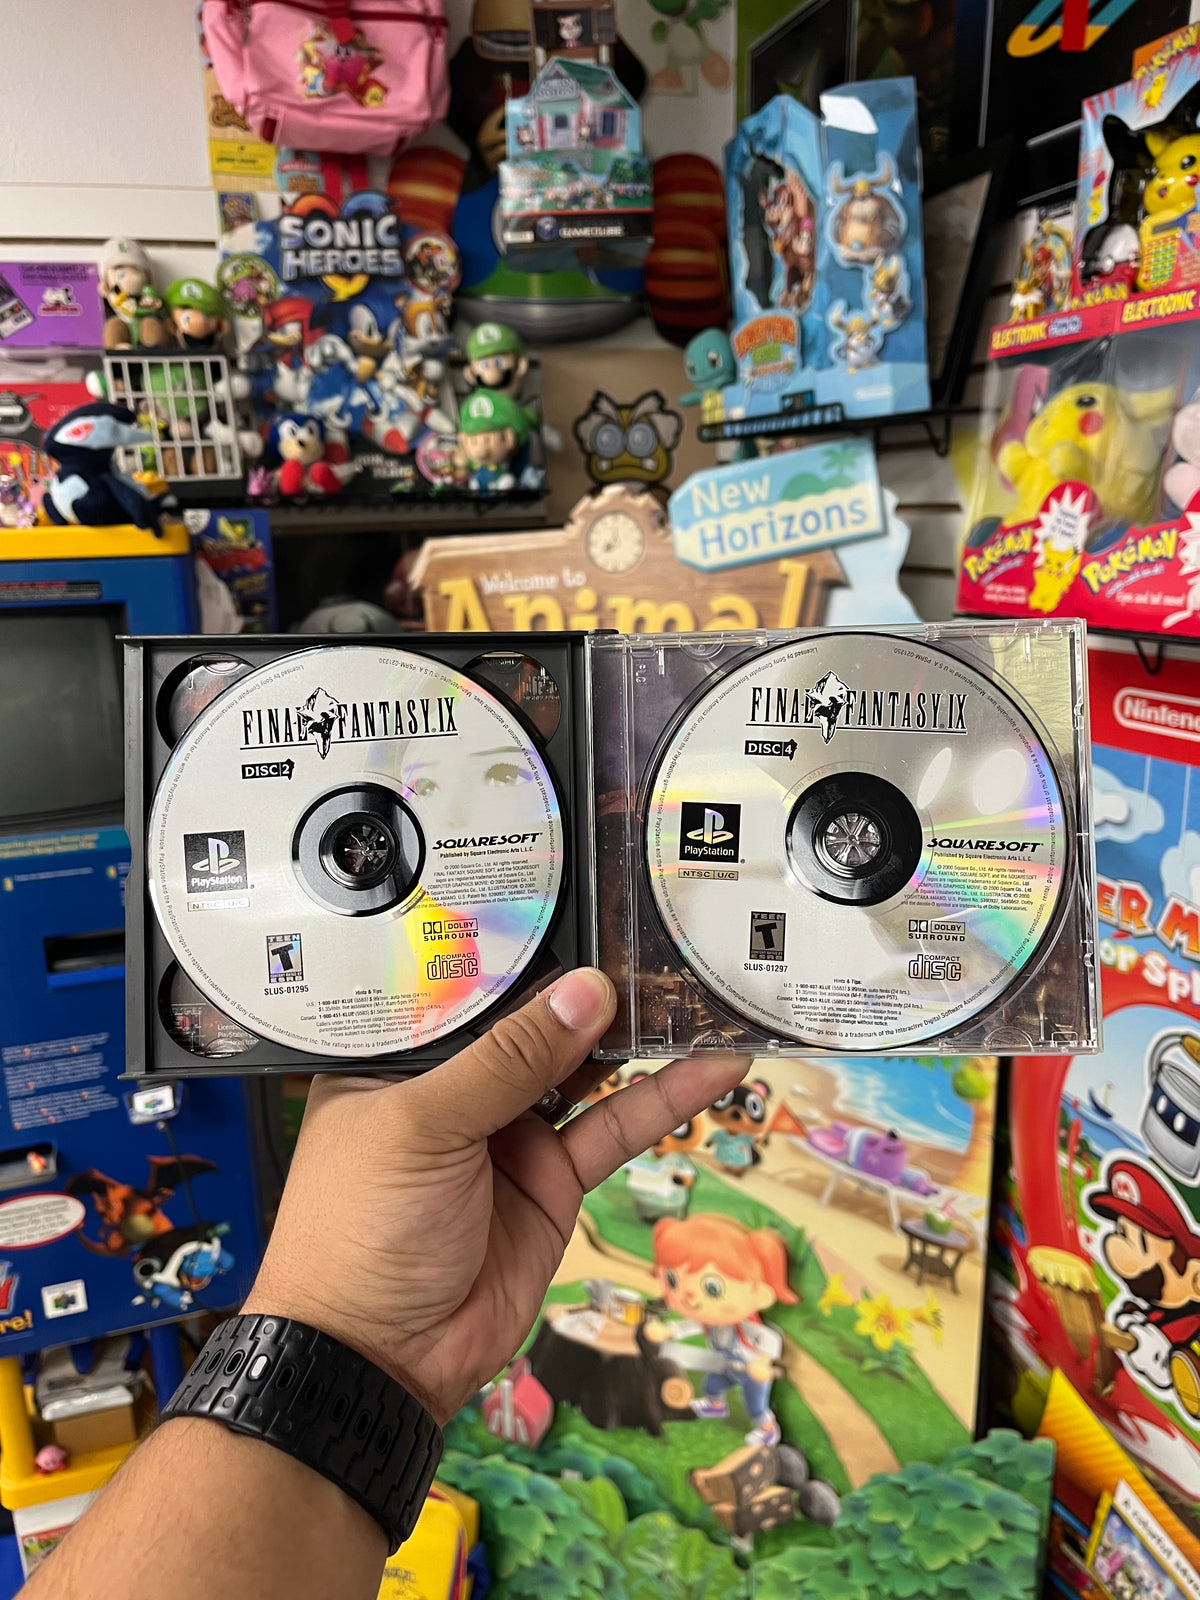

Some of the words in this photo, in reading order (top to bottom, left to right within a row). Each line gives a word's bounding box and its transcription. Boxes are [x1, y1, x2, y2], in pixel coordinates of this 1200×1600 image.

[279, 214, 400, 249] SONIC
[282, 249, 404, 281] HEROES
[1122, 289, 1196, 323] ELECTRONIC
[991, 321, 1048, 350] ELECTRONIC
[691, 474, 770, 517] New
[700, 494, 868, 560] Horizons
[480, 571, 559, 596] Welcome
[562, 569, 587, 589] to
[280, 664, 303, 676] Licensed
[259, 676, 272, 686] Sony
[439, 675, 472, 696] Manufactured
[236, 683, 260, 701] Computer
[207, 699, 237, 727] Entertainment
[482, 703, 504, 724] applicable
[750, 686, 814, 724] FINAL
[241, 706, 309, 746] FINAL
[193, 725, 210, 745] America
[506, 728, 523, 748] violation
[747, 742, 781, 755] DISC
[784, 743, 793, 755] 4
[176, 762, 186, 773] with
[244, 763, 279, 778] DISC
[281, 763, 290, 776] 2
[525, 756, 536, 770] game
[532, 770, 540, 780] this
[163, 782, 176, 812] PlayStation
[539, 787, 550, 812] broadcast
[432, 832, 542, 850] SQUARESOFT
[926, 838, 1041, 853] SQUARESOFT
[684, 845, 735, 858] PlayStation
[191, 875, 243, 889] PlayStation
[192, 901, 221, 910] NTSC
[228, 898, 246, 908] U/C
[166, 904, 180, 933] PlayStation
[447, 921, 475, 930] DOLBY
[754, 922, 778, 950] T
[934, 924, 962, 932] DOLBY
[177, 933, 187, 948] logos
[267, 934, 300, 942] TEEN
[424, 932, 479, 942] SURROUND
[908, 933, 966, 942] SURROUND
[184, 947, 192, 956] are
[270, 942, 294, 972] T
[441, 952, 476, 960] COMPACT
[505, 944, 529, 974] Unauthorized
[190, 956, 209, 979] registered
[426, 954, 479, 980] disc
[743, 962, 788, 972] SLUS-01297
[908, 954, 962, 982] disc
[207, 978, 231, 1001] trademarks
[264, 984, 309, 996] SLUS-01295
[235, 1003, 248, 1014] Sony
[462, 997, 483, 1014] Software
[248, 1012, 272, 1028] Computer
[446, 1011, 463, 1024] Digital
[805, 1025, 823, 1034] ratings
[895, 1021, 923, 1033] Interactive
[923, 1014, 941, 1025] Digital
[940, 1003, 963, 1018] Software
[272, 1025, 308, 1041] Entertainment
[420, 1020, 446, 1036] Interactive
[376, 1037, 402, 1046] trademark
